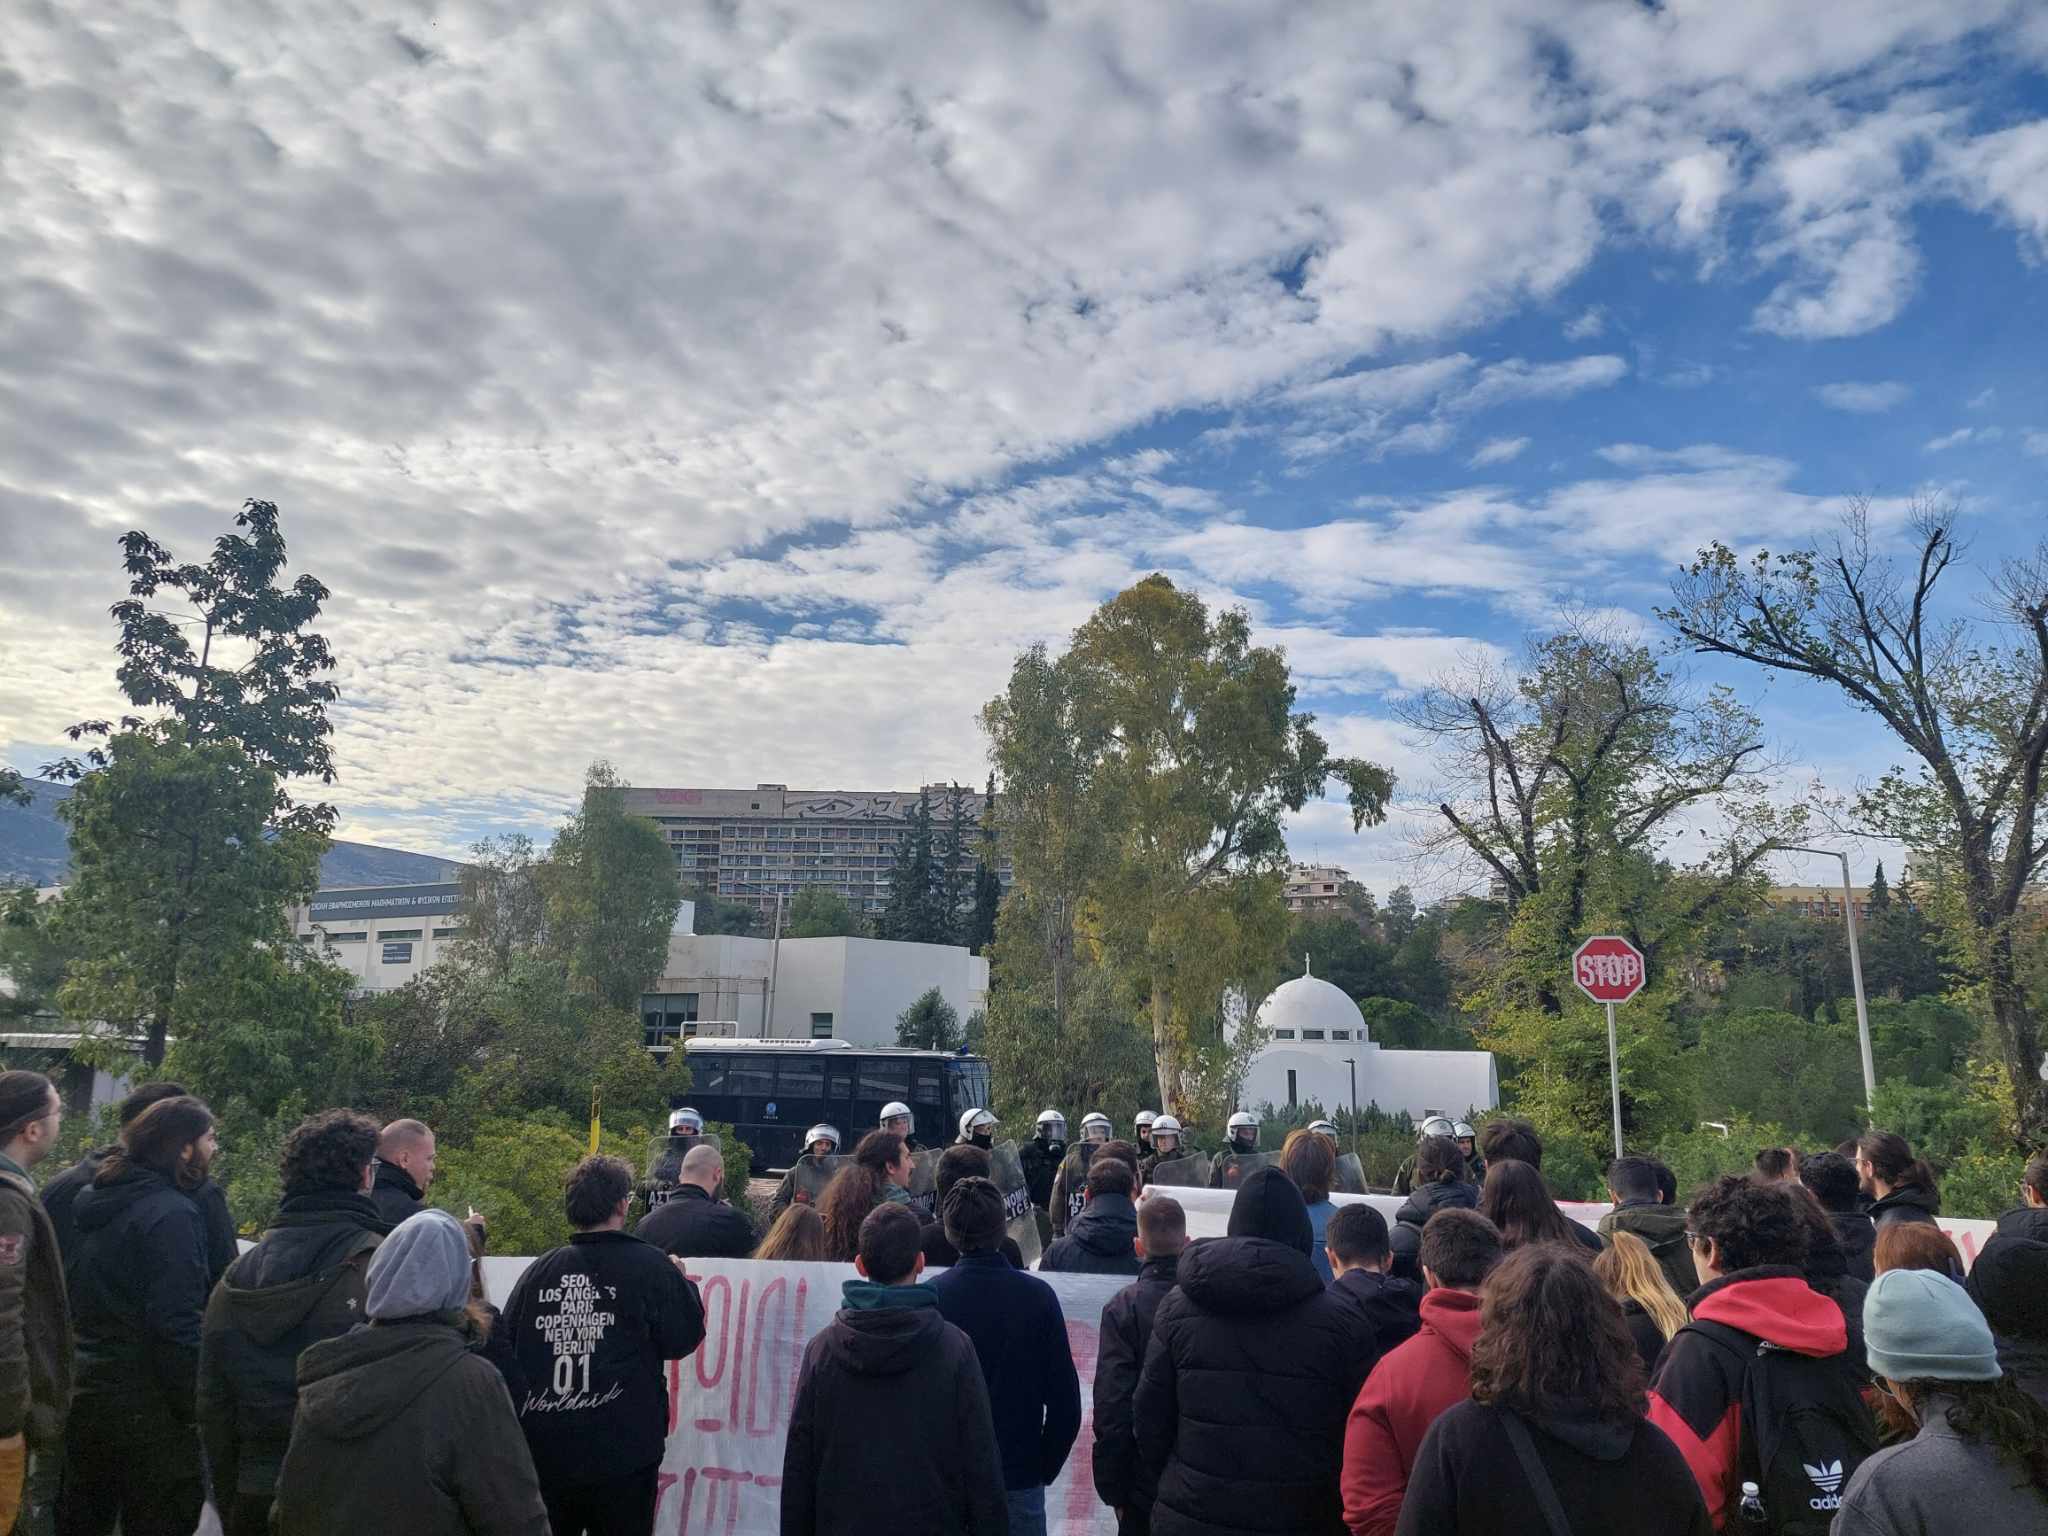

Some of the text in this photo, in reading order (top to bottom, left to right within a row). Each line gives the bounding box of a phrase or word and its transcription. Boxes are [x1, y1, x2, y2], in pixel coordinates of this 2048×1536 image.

[1580, 955, 1639, 987] STOP
[538, 1286, 617, 1303] LOS ANGELS
[560, 1299, 594, 1314] PARIS
[535, 1312, 615, 1330] COPENHAGEN
[544, 1326, 604, 1343] NEW YORK
[553, 1339, 596, 1355] BERLIN
[553, 1354, 591, 1395] 01
